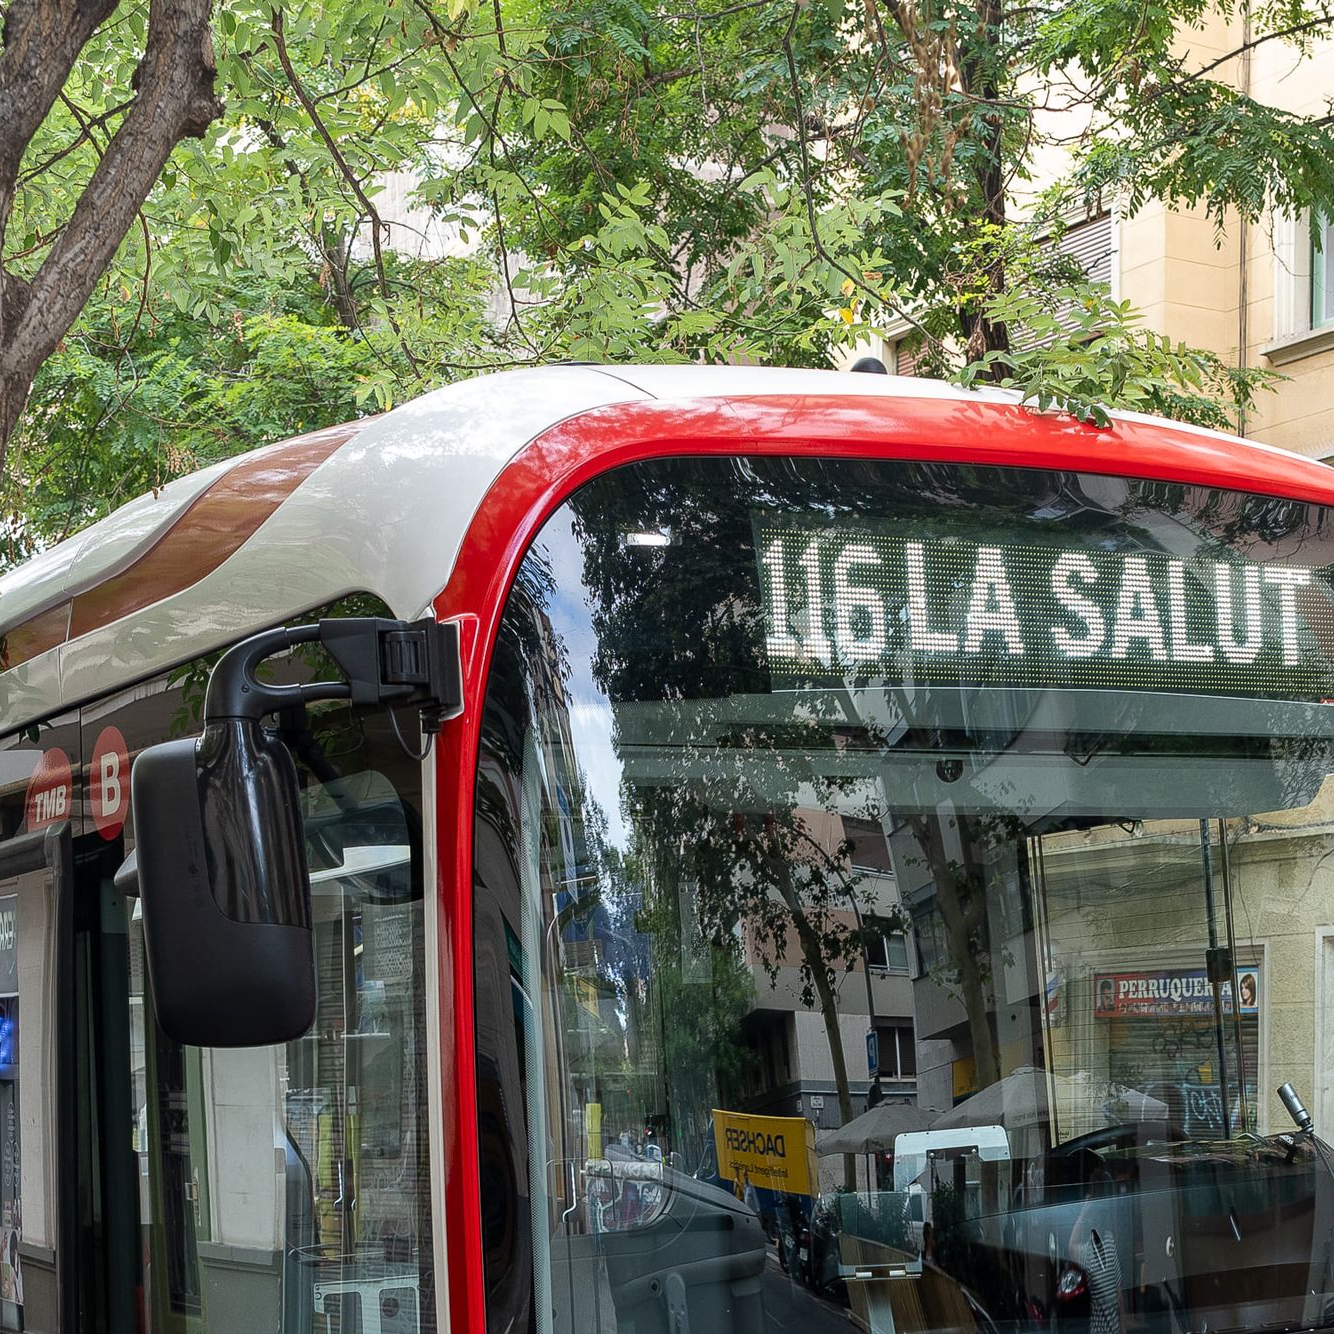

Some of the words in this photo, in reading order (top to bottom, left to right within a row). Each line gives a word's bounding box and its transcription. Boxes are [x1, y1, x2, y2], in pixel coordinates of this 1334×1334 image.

[762, 539, 887, 662] 116
[906, 542, 1026, 656] LA
[1050, 552, 1314, 667] SALUT
[34, 785, 66, 823] TMB
[100, 752, 121, 817] B
